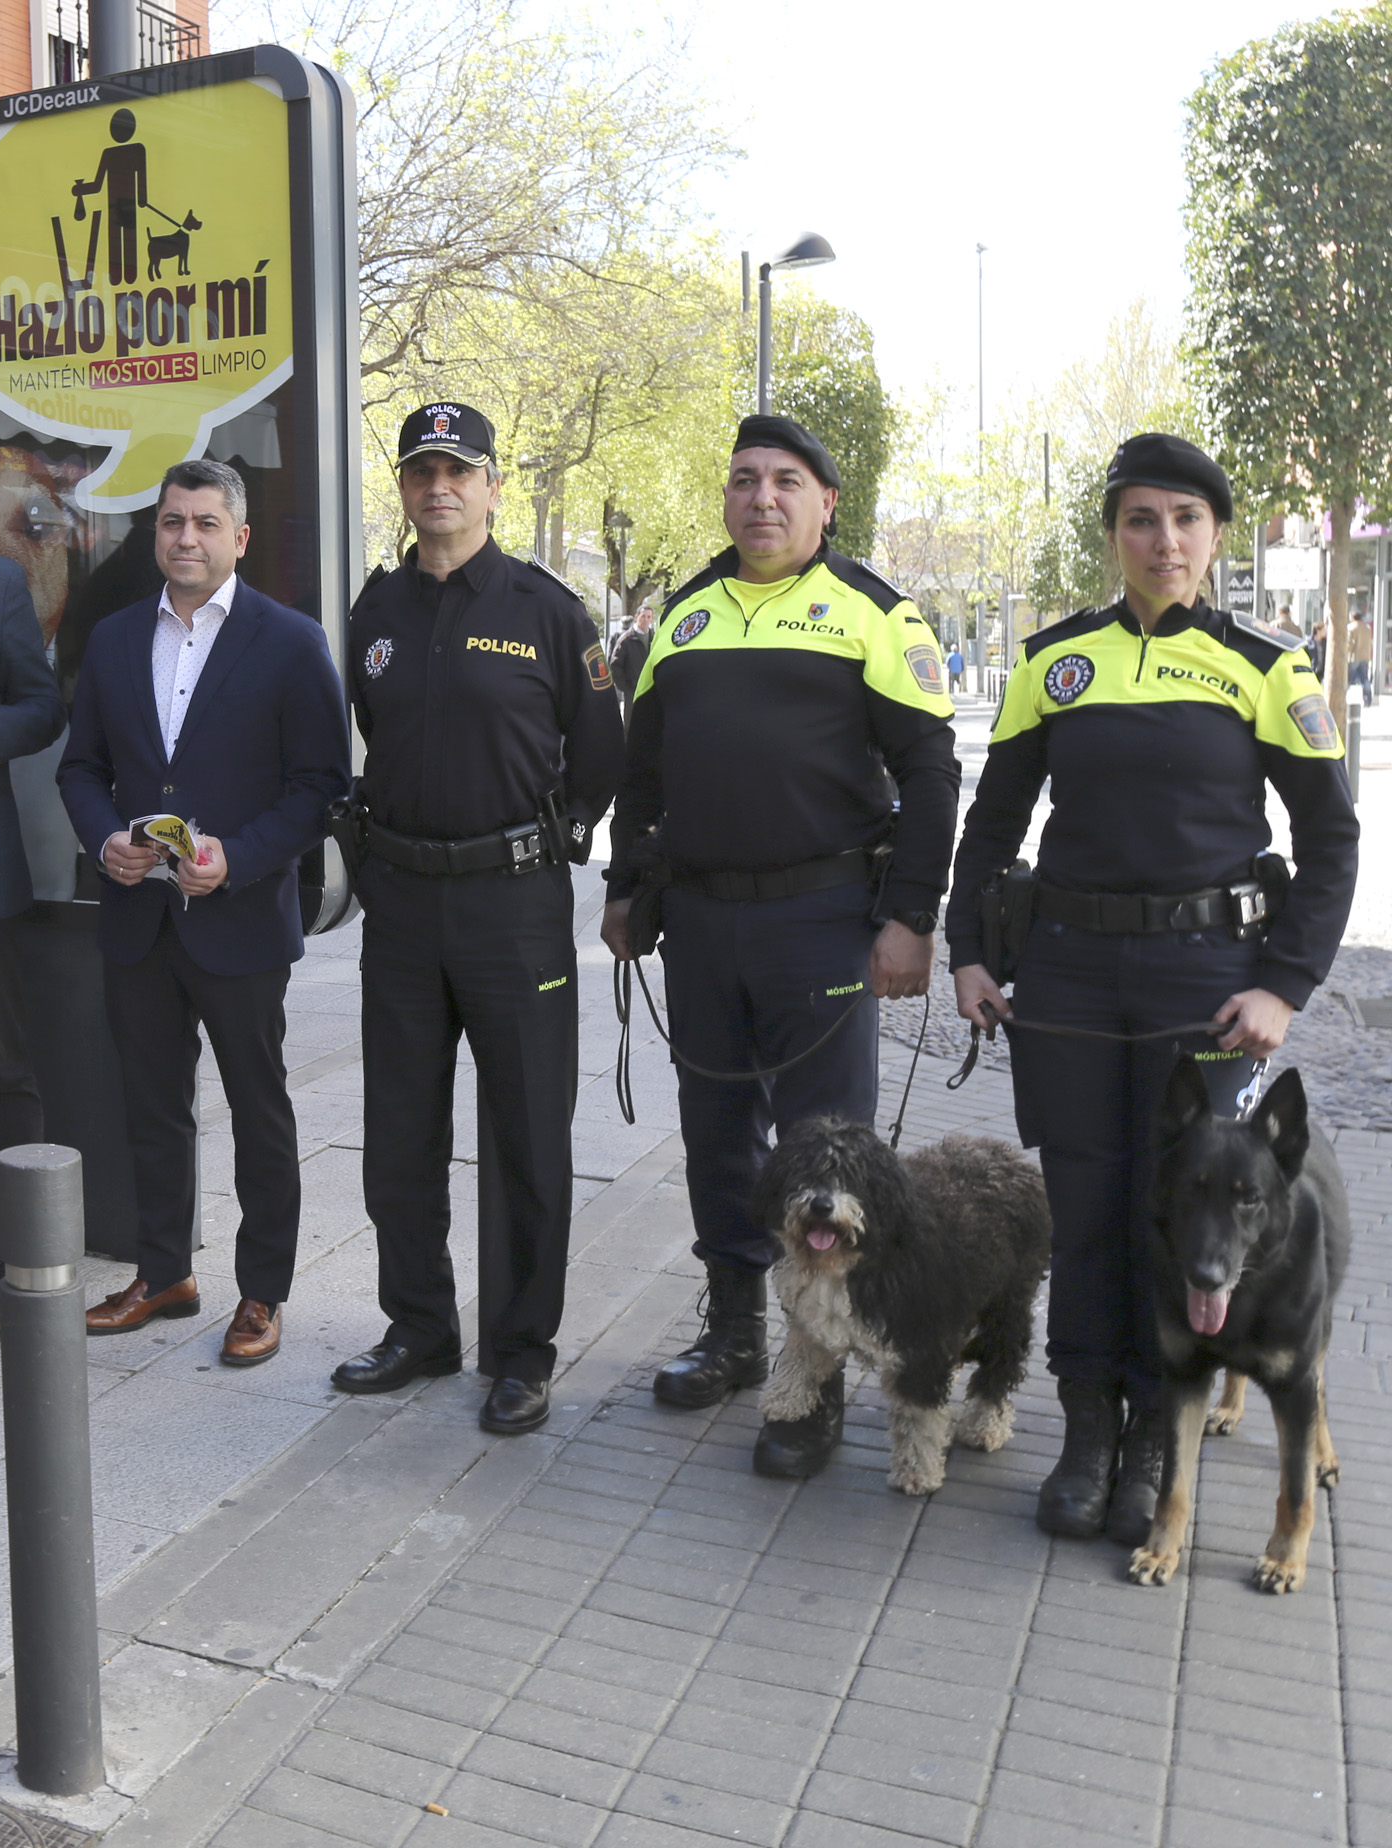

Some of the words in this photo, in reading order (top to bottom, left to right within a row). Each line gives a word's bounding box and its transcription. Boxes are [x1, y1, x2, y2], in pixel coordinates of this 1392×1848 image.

[3, 85, 101, 118] JCDecaux
[115, 283, 196, 357] por
[206, 259, 270, 341] mí
[9, 364, 85, 393] MANTÉN
[91, 356, 196, 386] MÓSTOLES
[201, 349, 267, 376] LIMPIO
[426, 405, 461, 418] POLICIA
[421, 433, 460, 441] MÓSTOLES
[776, 619, 845, 636] POLICIA
[466, 637, 537, 660] POLICIA
[1157, 656, 1239, 698] POLICIA
